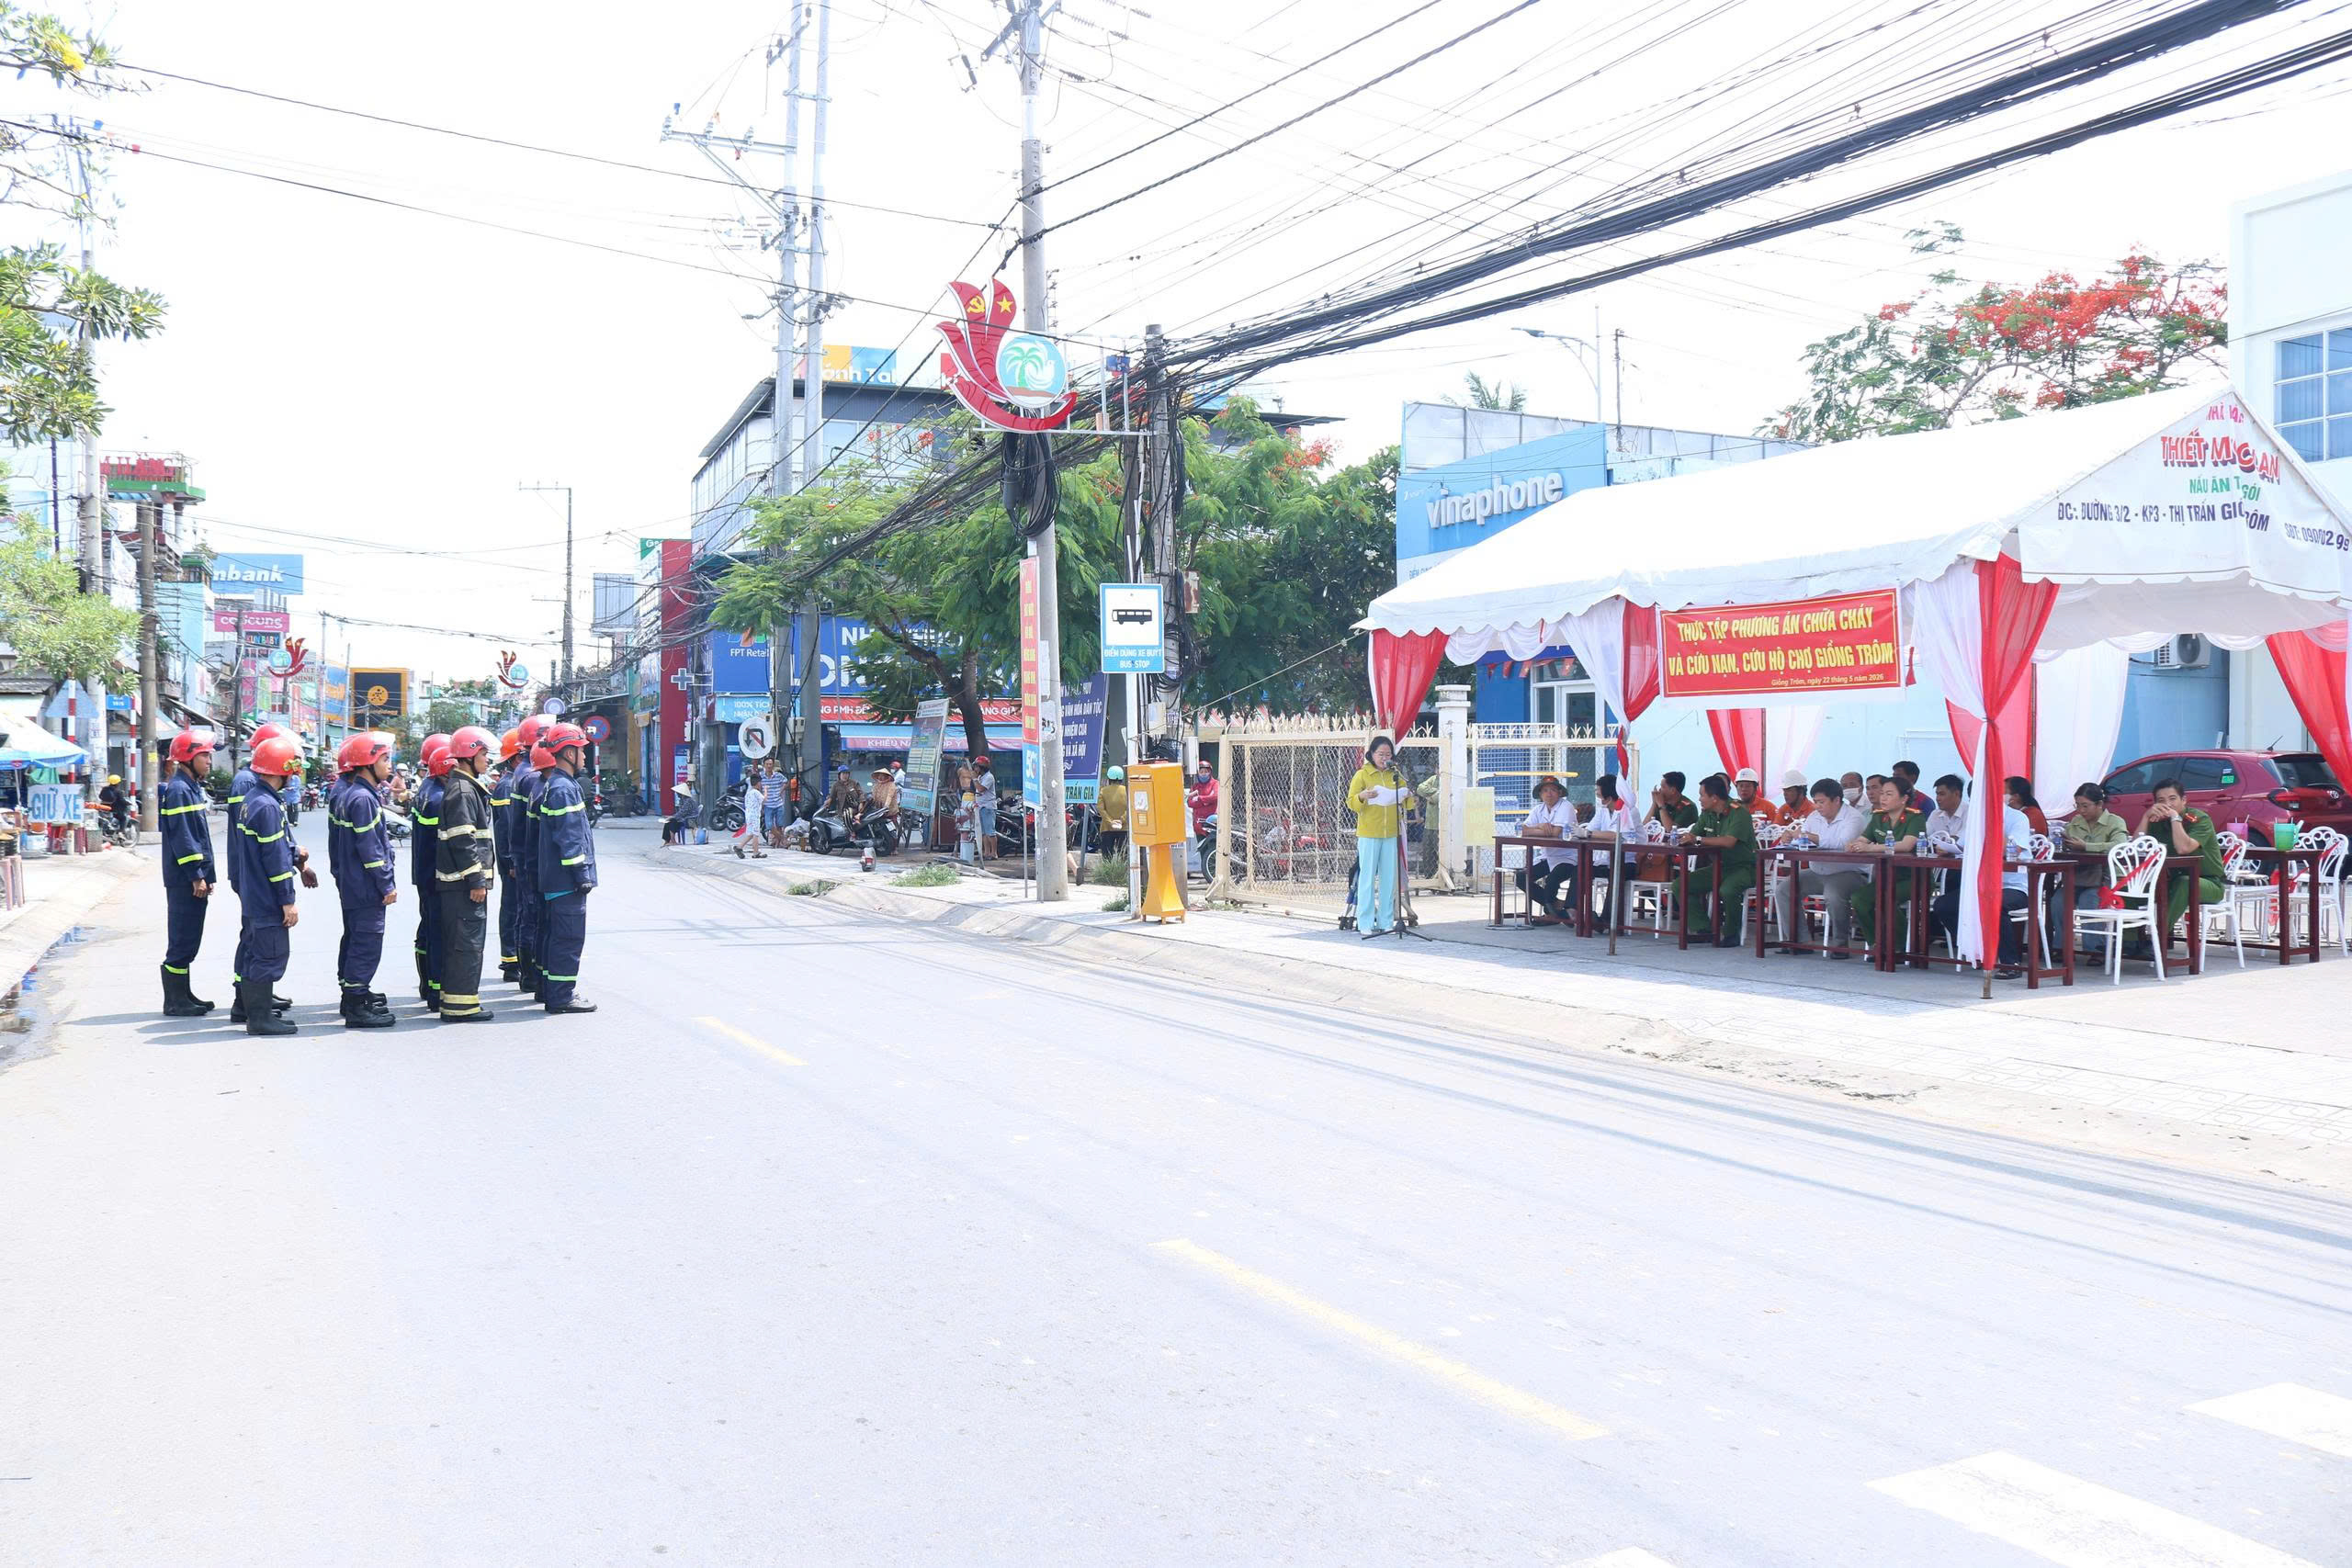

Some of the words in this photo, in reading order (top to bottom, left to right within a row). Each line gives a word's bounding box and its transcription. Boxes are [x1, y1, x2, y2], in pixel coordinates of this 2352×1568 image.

[2161, 427, 2209, 467] THIẾT
[2211, 435, 2256, 473] MC
[1426, 471, 1564, 530] vinaphone
[2114, 505, 2132, 523] 3/2
[2142, 505, 2160, 523] KP3
[2169, 504, 2186, 526] THỊ
[1677, 620, 1707, 646] THỰC
[1707, 616, 1729, 644] TẬP
[1731, 615, 1780, 638] PHƯƠNG
[1781, 611, 1801, 635] ÁN
[1803, 607, 1838, 633] CHỮA
[1839, 604, 1874, 630] CHÁY
[730, 649, 745, 657] FPT
[746, 648, 770, 658] Retail
[1137, 649, 1147, 658] XE
[1668, 652, 1684, 676] VÀ
[1686, 651, 1710, 675] CỨU
[1711, 653, 1740, 678] NẠN,
[1742, 648, 1766, 672] CỨU
[1769, 646, 1786, 675] HỘ
[1788, 646, 1813, 674] CHỢ
[1815, 639, 1855, 669] GIỒNG
[1856, 638, 1894, 666] TRÔM
[1120, 660, 1132, 669] BUS
[1134, 660, 1150, 669] STOP
[1823, 675, 1830, 683] 22
[1831, 674, 1848, 684] tháng
[1854, 673, 1867, 682] năm
[32, 787, 58, 820] GIỮ
[62, 793, 82, 820] XE
[1083, 786, 1094, 800] GIA
